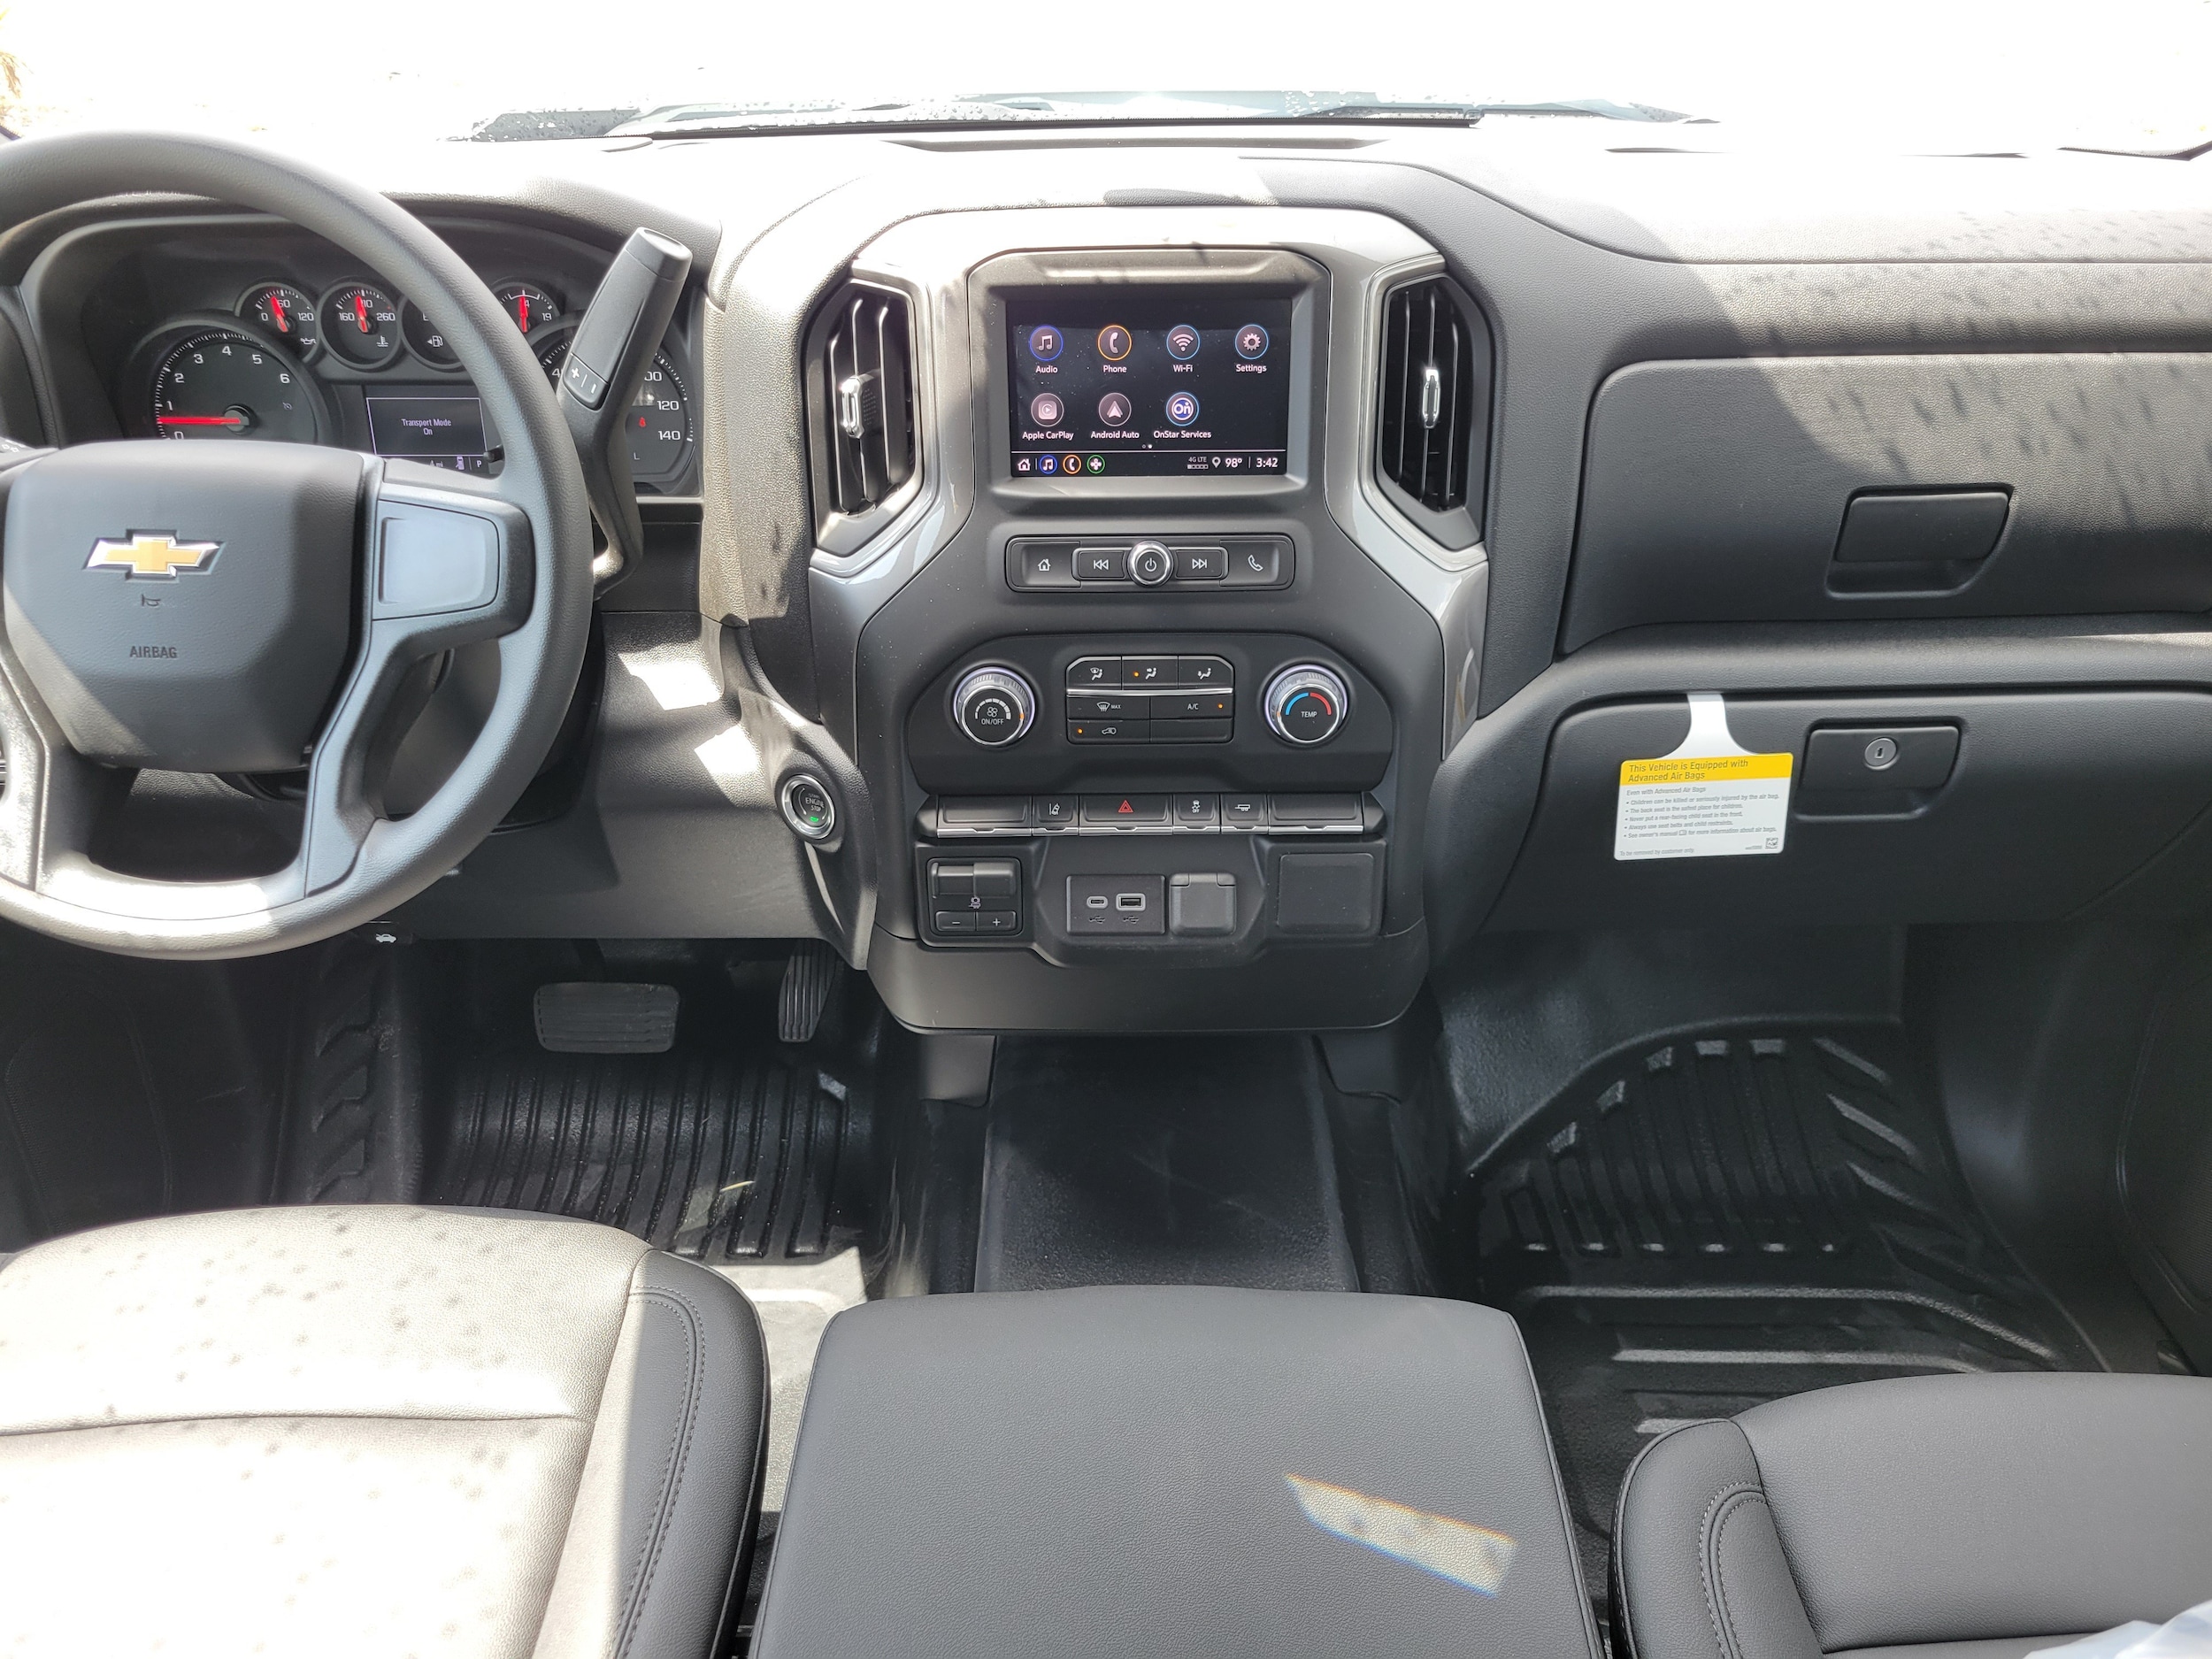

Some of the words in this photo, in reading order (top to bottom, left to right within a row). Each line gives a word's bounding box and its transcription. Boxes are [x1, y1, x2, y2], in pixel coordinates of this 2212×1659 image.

[297, 312, 314, 321] 120
[339, 312, 355, 321] 160
[376, 312, 396, 321] 260
[221, 345, 232, 356] 4
[194, 354, 204, 365] 3
[251, 354, 263, 365] 5
[1035, 365, 1058, 373] Audio
[1102, 365, 1127, 373] Phone
[1235, 364, 1267, 374] Settings
[173, 373, 185, 383] 2
[280, 373, 290, 384] 6
[644, 372, 663, 381] 00
[166, 401, 173, 411] 1
[657, 400, 680, 411] 120
[401, 419, 432, 427] Transport
[658, 430, 680, 441] 140
[1022, 431, 1044, 441] Apple
[1046, 431, 1074, 441] CarPlay
[1154, 430, 1179, 439] OnStar
[1181, 430, 1212, 439] Services
[1256, 457, 1278, 468] 3:42
[129, 646, 177, 658] AIRBAG
[1649, 763, 1678, 772] Vehicle
[1690, 760, 1728, 770] Equipped
[1628, 773, 1669, 782] Advanced
[1685, 772, 1705, 780] Bags
